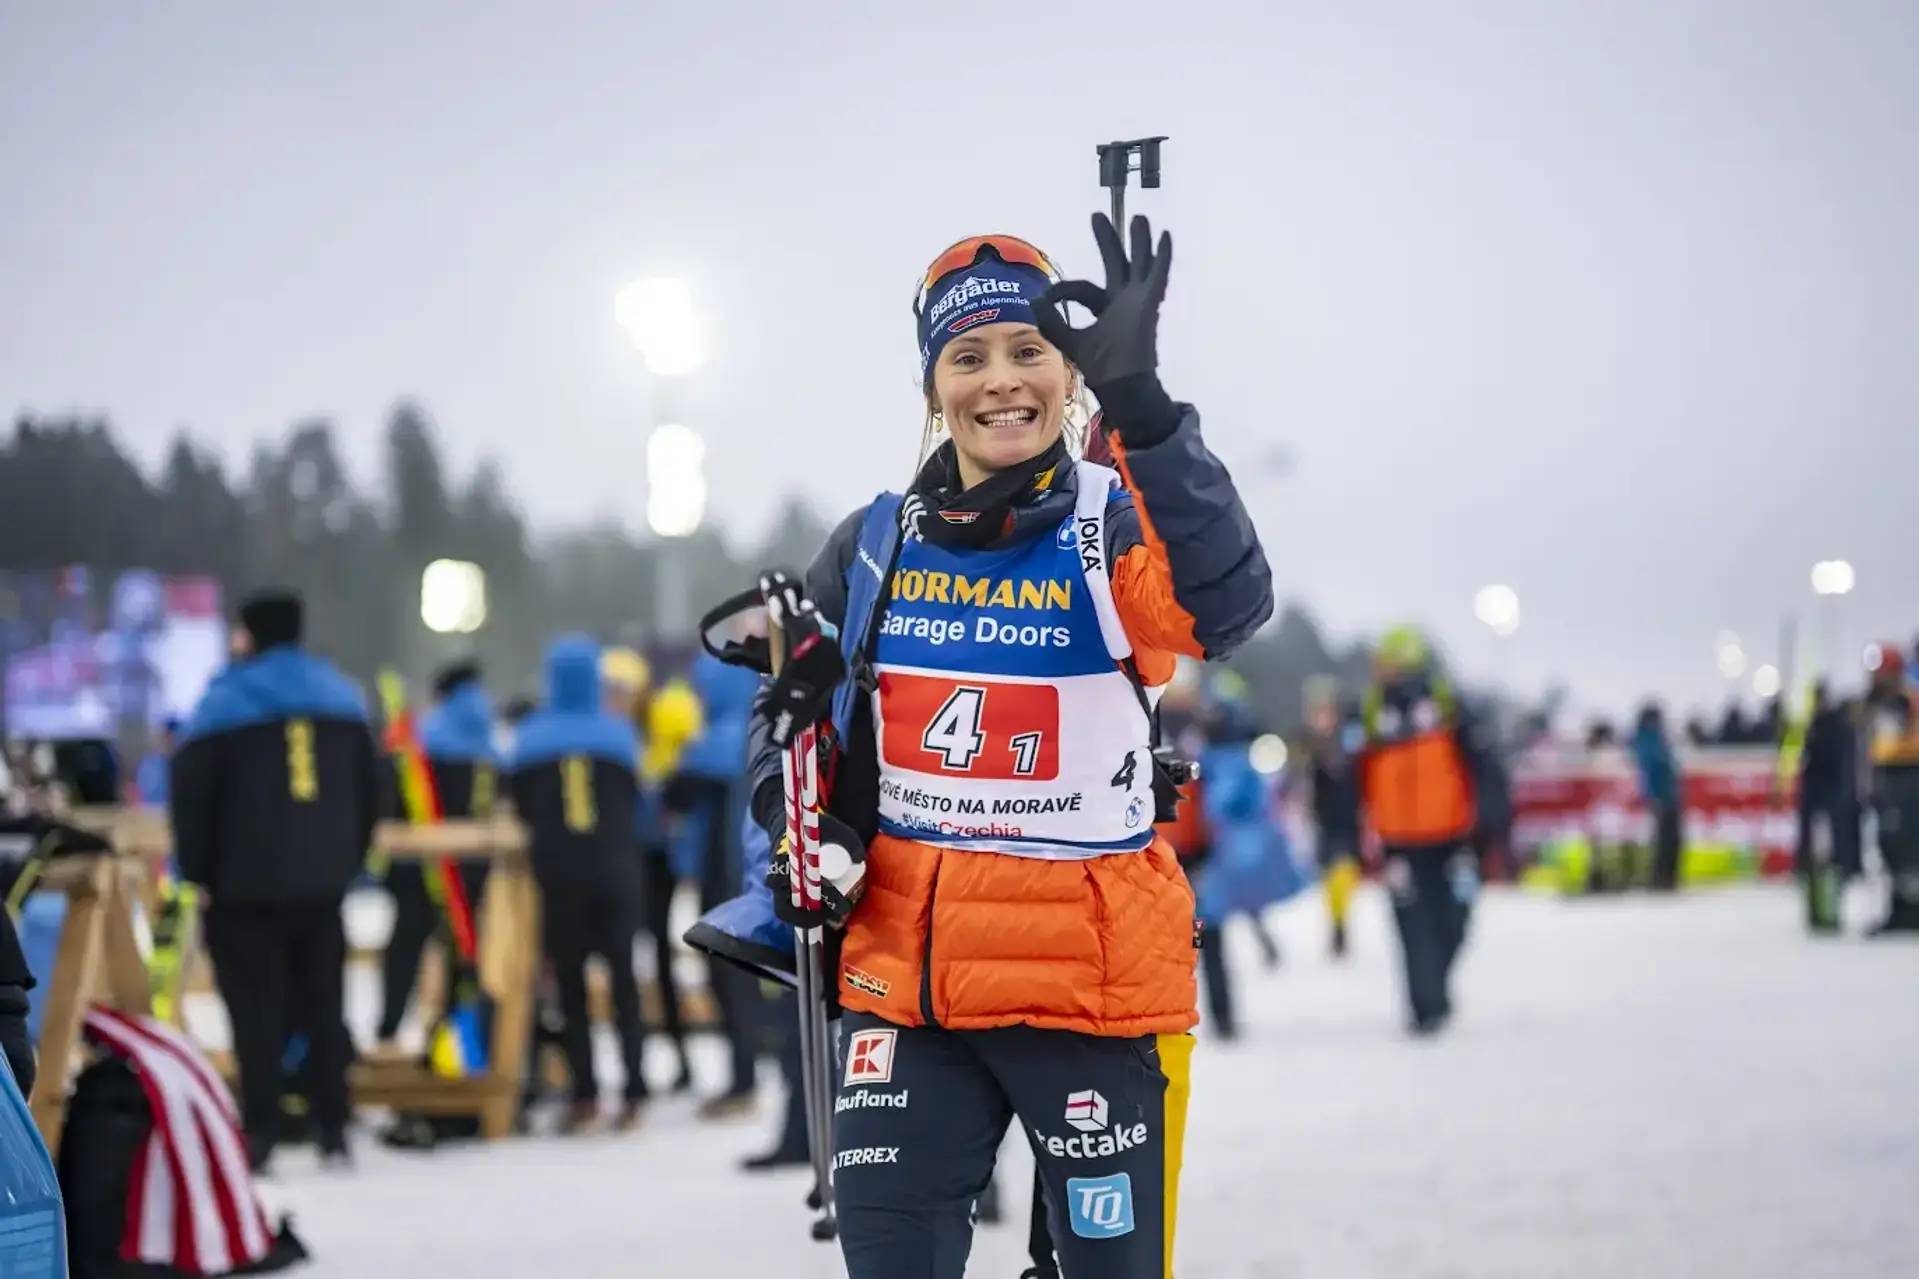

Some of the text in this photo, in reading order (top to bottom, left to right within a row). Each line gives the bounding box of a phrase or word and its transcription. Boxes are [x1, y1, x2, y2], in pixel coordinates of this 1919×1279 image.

[930, 278, 1020, 325] Bergader
[1078, 517, 1101, 574] JOKA
[879, 609, 1071, 647] Garage Doors
[921, 685, 1042, 775] 4 1
[1111, 750, 1137, 792] 4
[902, 788, 952, 812] MĚSTO
[957, 799, 985, 814] NA
[992, 792, 1082, 814] MORAVĚ
[837, 1147, 899, 1168] TERREX
[1076, 1185, 1125, 1229] TQ
